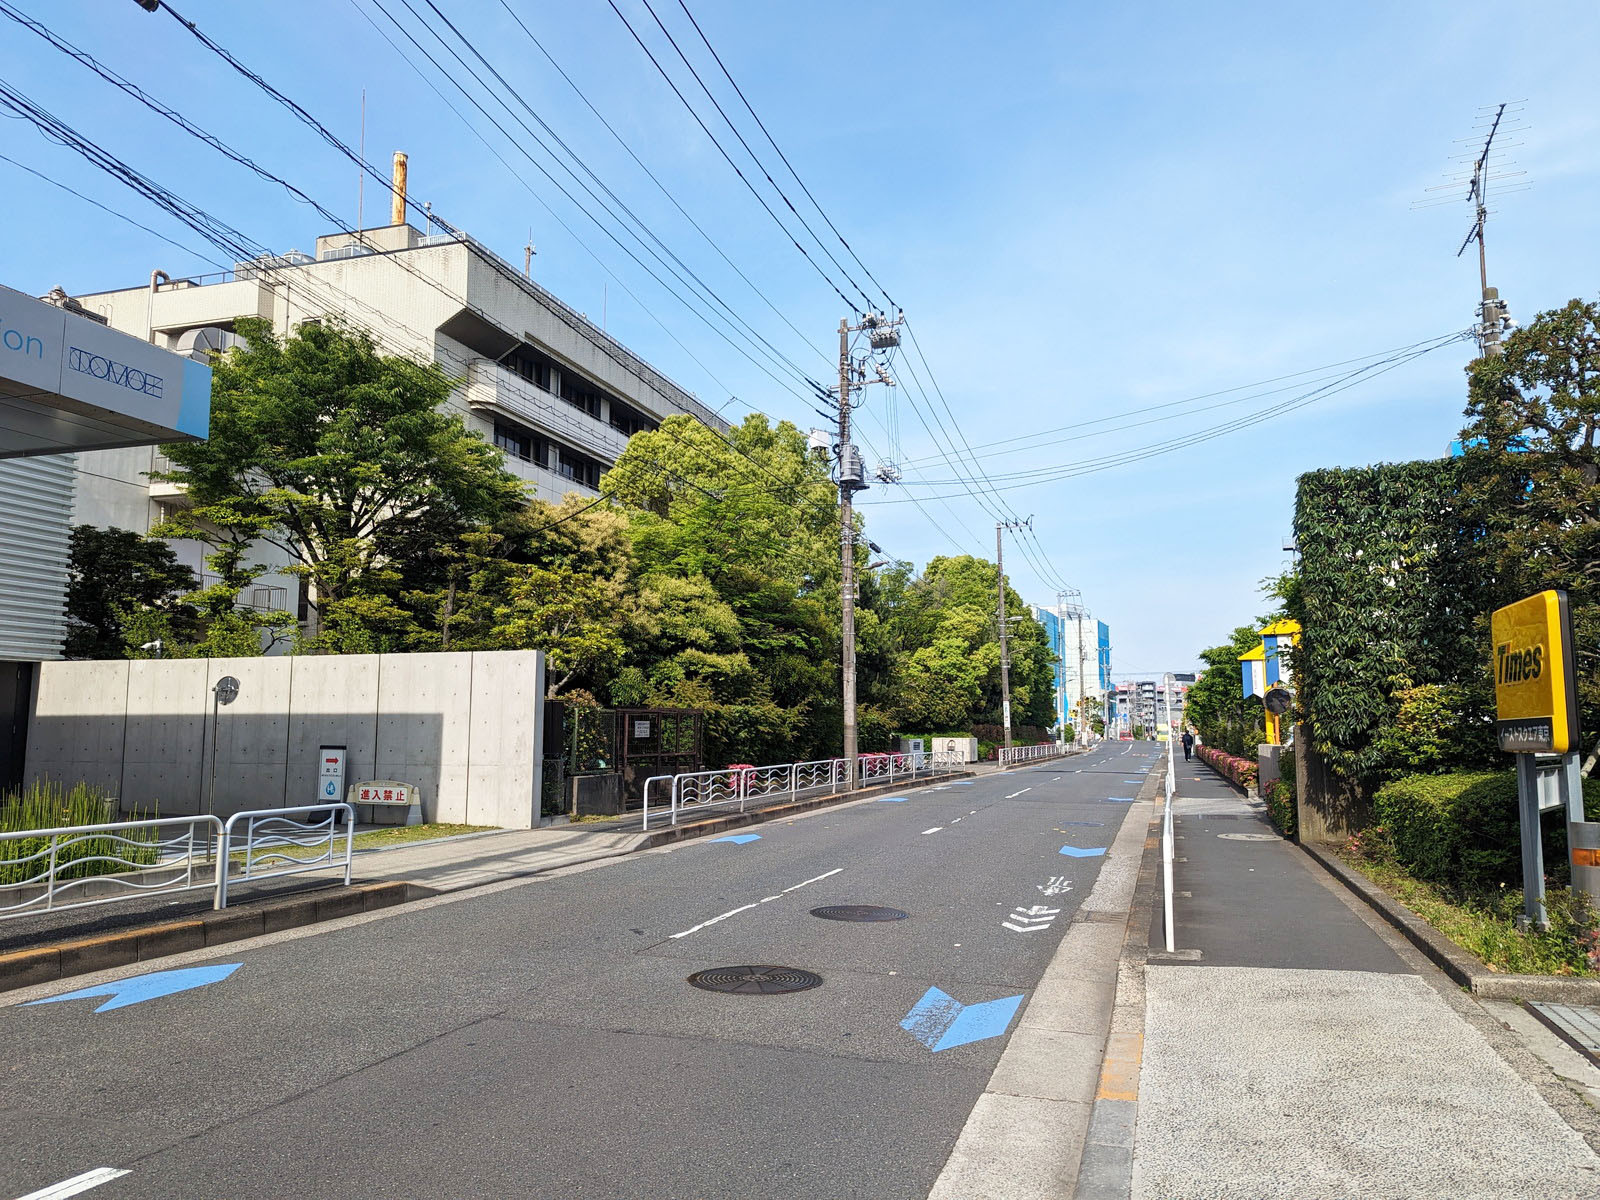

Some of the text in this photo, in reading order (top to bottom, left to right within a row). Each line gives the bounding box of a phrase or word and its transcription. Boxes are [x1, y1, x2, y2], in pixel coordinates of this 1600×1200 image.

[0, 319, 42, 359] on
[69, 346, 163, 399] TOMOE
[1498, 644, 1543, 685] Times
[360, 789, 405, 802] 進入禁止
